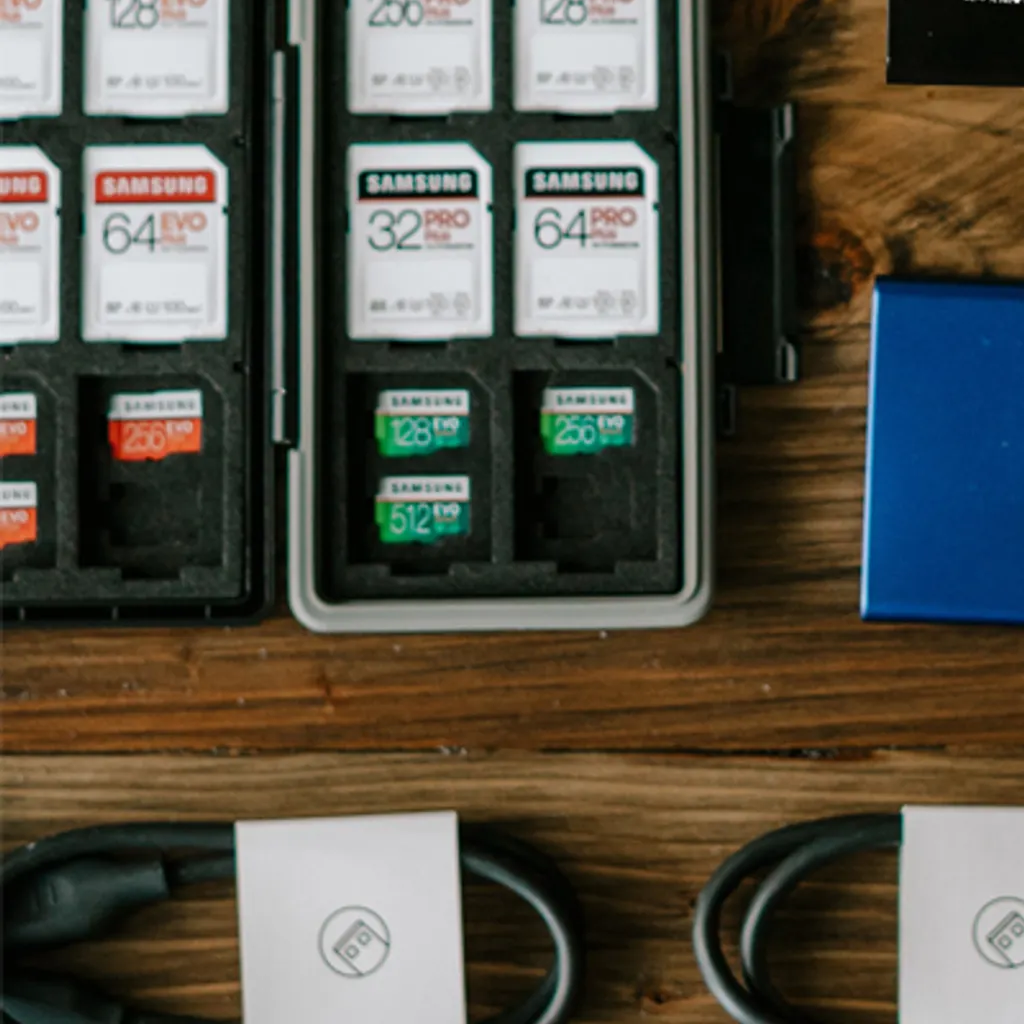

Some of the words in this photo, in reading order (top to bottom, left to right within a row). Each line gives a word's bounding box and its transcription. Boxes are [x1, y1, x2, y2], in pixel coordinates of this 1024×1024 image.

[102, 175, 209, 198] SAMSUNG
[366, 171, 473, 194] SAMSUNG
[532, 170, 640, 193] SAMSUNG
[102, 210, 157, 256] 64
[160, 210, 208, 233] EVO
[367, 208, 423, 252] 32
[424, 207, 472, 229] PRO
[533, 206, 590, 250] 64
[590, 206, 638, 228] PRO
[124, 398, 197, 414] SAMSUNG
[391, 395, 464, 408] SAMSUNG
[555, 394, 628, 407] SAMSUNG
[122, 422, 167, 455] 256
[390, 416, 432, 447] 128
[432, 416, 460, 432] EVO
[555, 415, 597, 446] 256
[597, 414, 626, 431] EVO
[391, 482, 464, 495] SAMSUNG
[390, 502, 432, 535] 512
[432, 502, 461, 518] EVO
